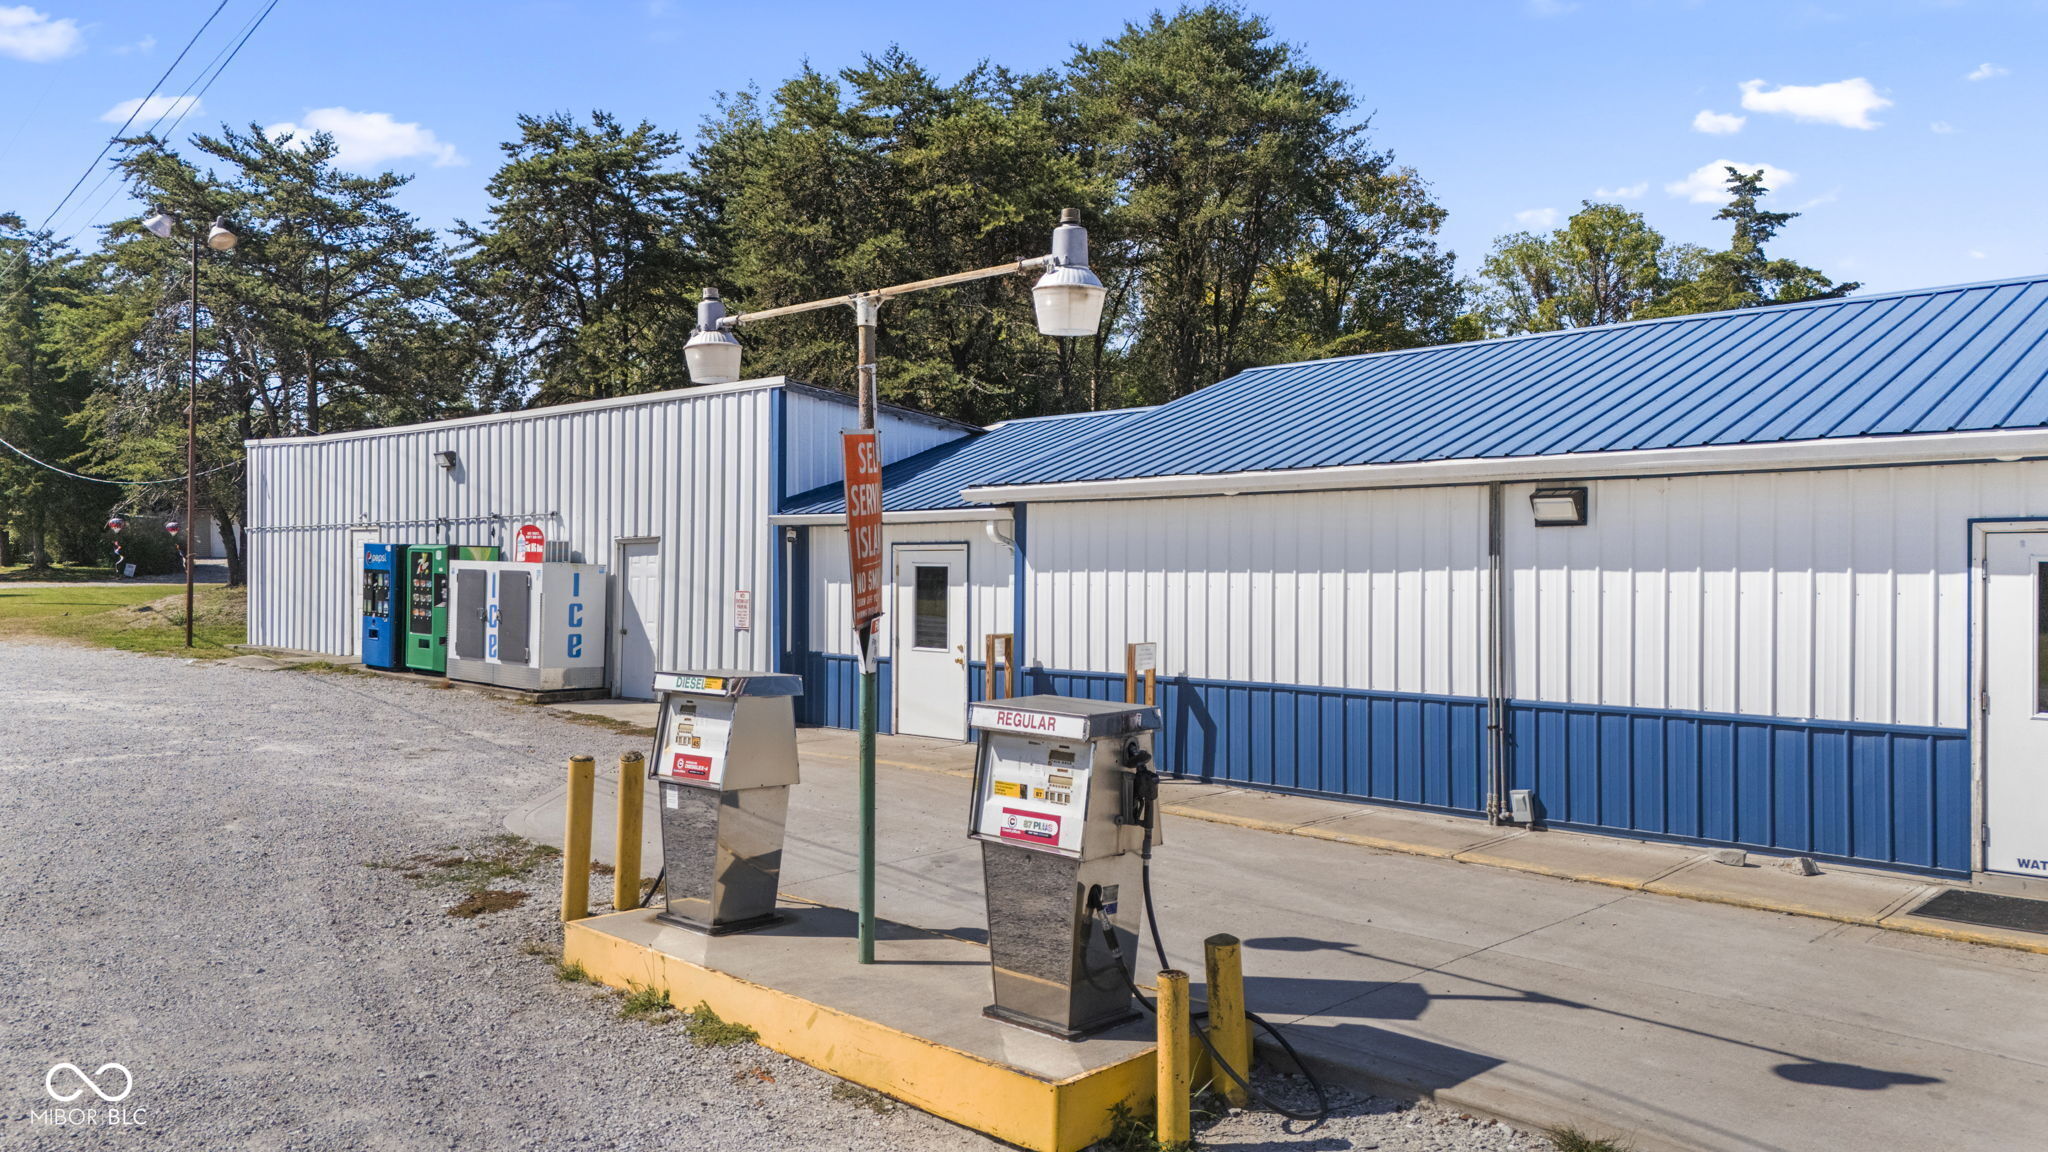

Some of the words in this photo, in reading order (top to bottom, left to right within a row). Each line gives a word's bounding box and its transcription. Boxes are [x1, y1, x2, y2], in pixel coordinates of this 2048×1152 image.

[856, 571, 867, 594] NO
[676, 675, 705, 690] DIESEL
[996, 711, 1057, 732] REGULAR
[1033, 821, 1053, 832] PLUS
[2017, 858, 2048, 870] WAT
